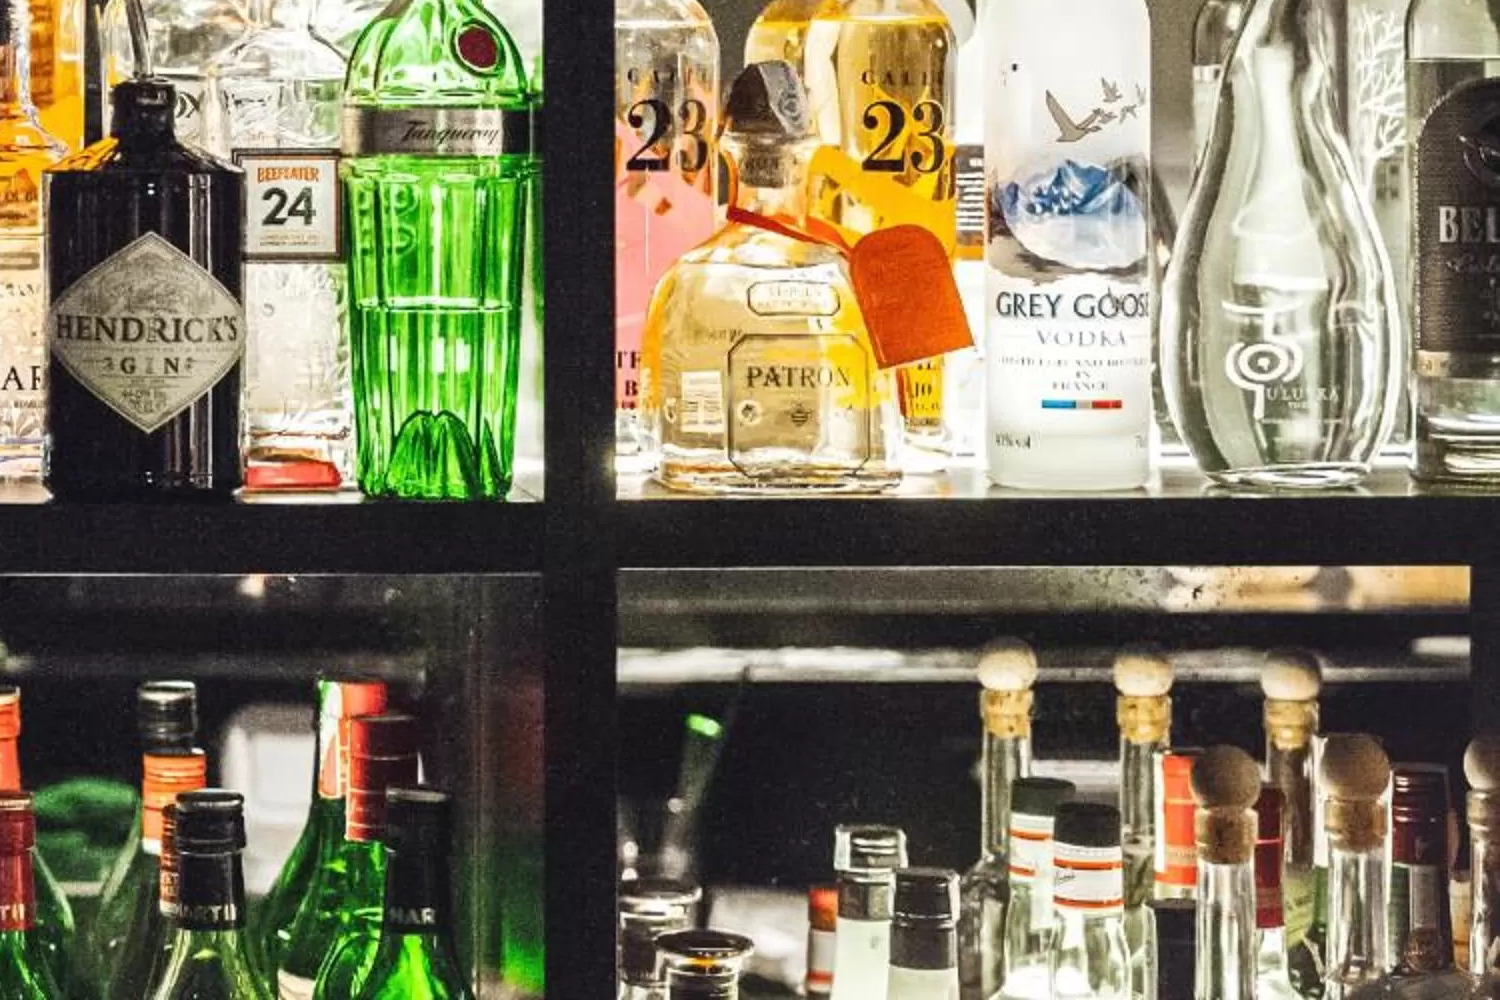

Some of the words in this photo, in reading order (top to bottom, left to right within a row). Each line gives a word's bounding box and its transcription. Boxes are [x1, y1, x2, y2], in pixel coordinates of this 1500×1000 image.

[401, 120, 499, 146] Tanqueray
[626, 100, 708, 171] 23
[861, 100, 946, 172] 23
[257, 167, 319, 184] BEEFEATER
[262, 186, 317, 226] 24
[996, 291, 1063, 319] GREY
[55, 314, 239, 343] HENDRICK'S
[1036, 330, 1126, 347] VODKA
[119, 356, 181, 375] GIN
